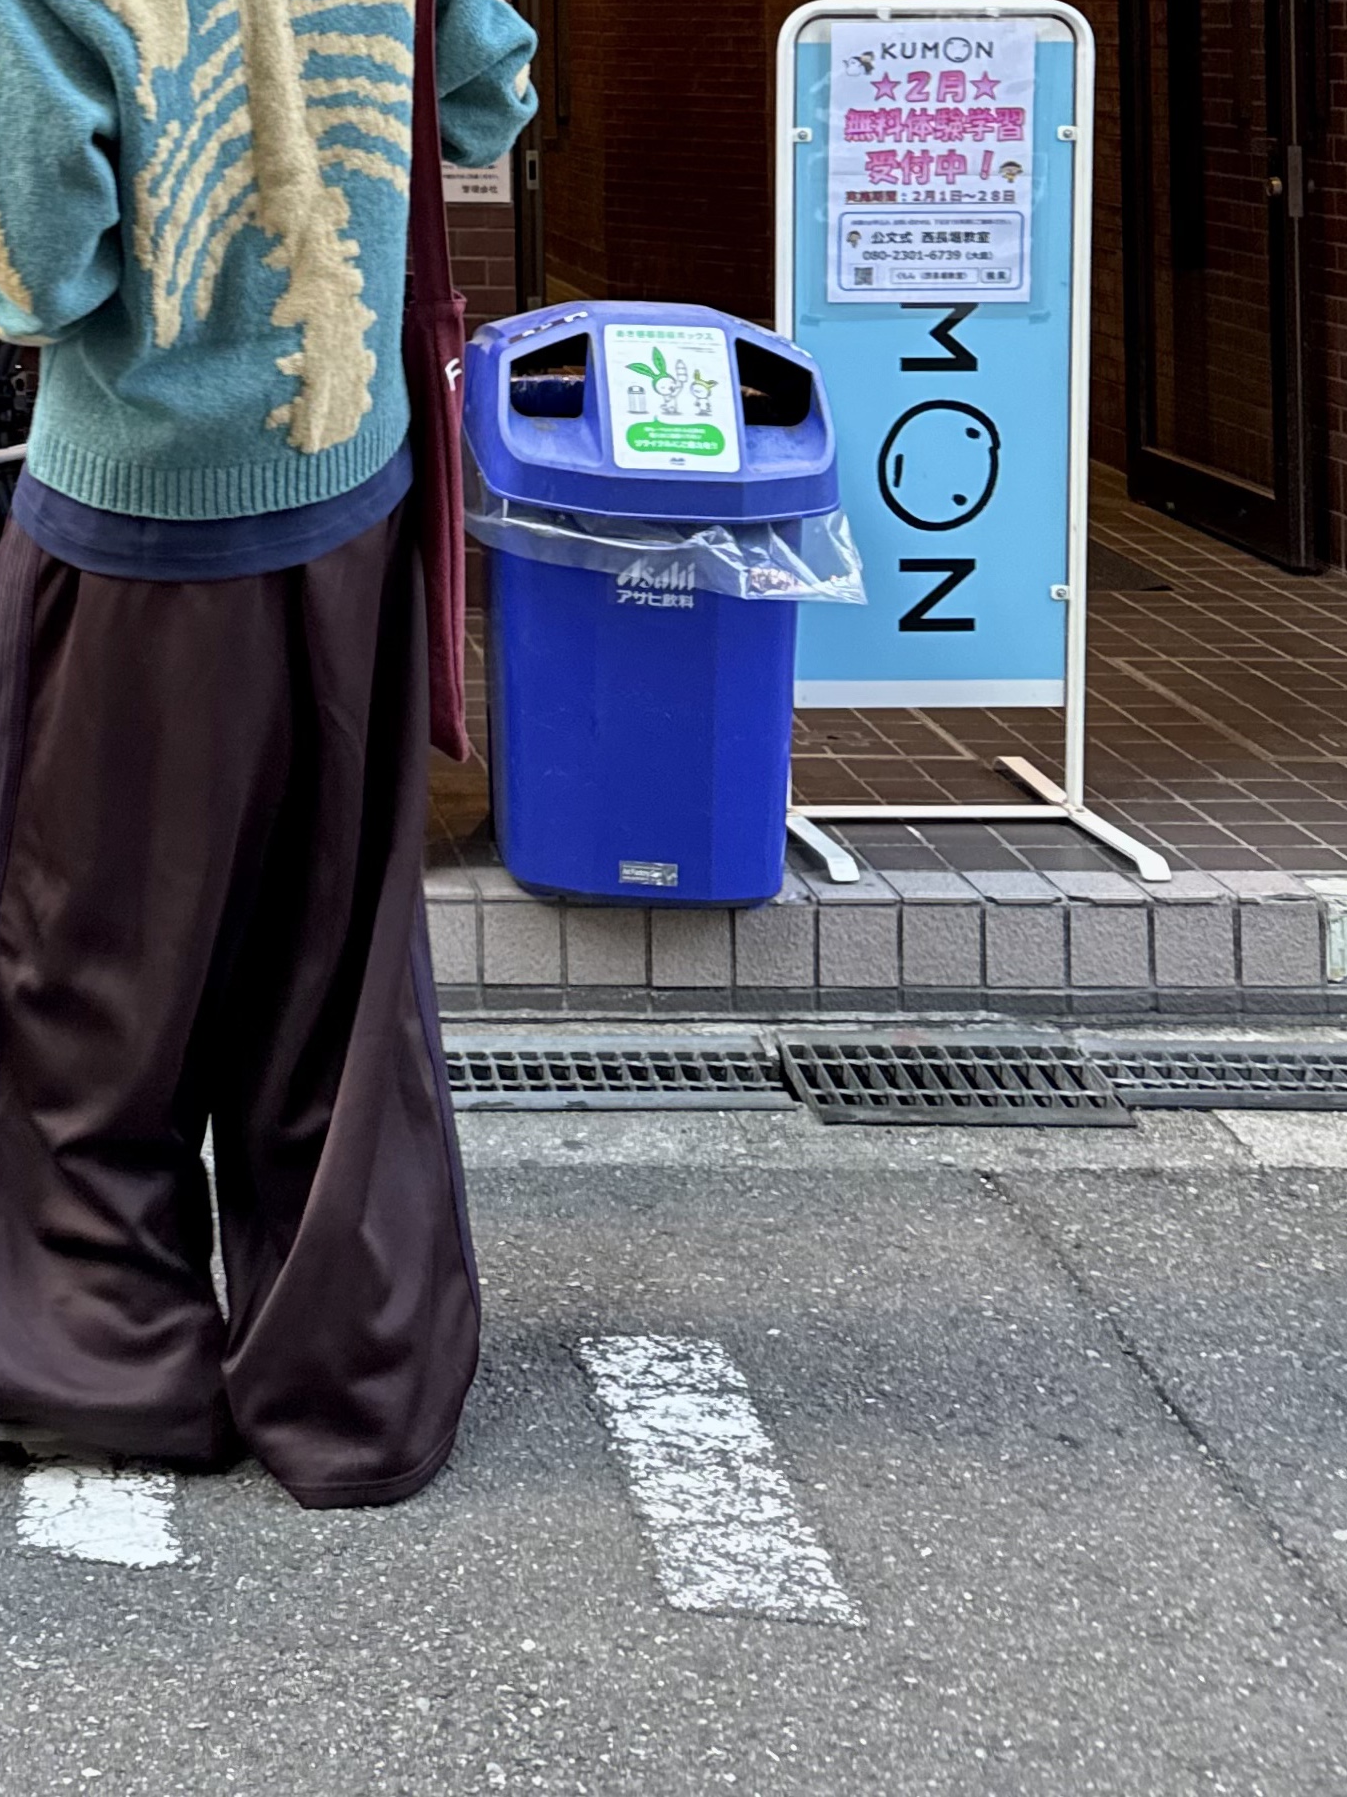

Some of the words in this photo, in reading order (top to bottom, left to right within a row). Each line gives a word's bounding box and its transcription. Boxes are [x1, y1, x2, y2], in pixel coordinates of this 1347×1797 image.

[880, 37, 994, 63] KUMON
[844, 108, 1025, 143] 無料体験学習
[865, 149, 995, 185] 受付中!
[871, 231, 913, 244] 公文式
[922, 231, 991, 244] 西長堀教室
[617, 558, 695, 591] Asahi
[616, 590, 694, 608] アサヒ飲料
